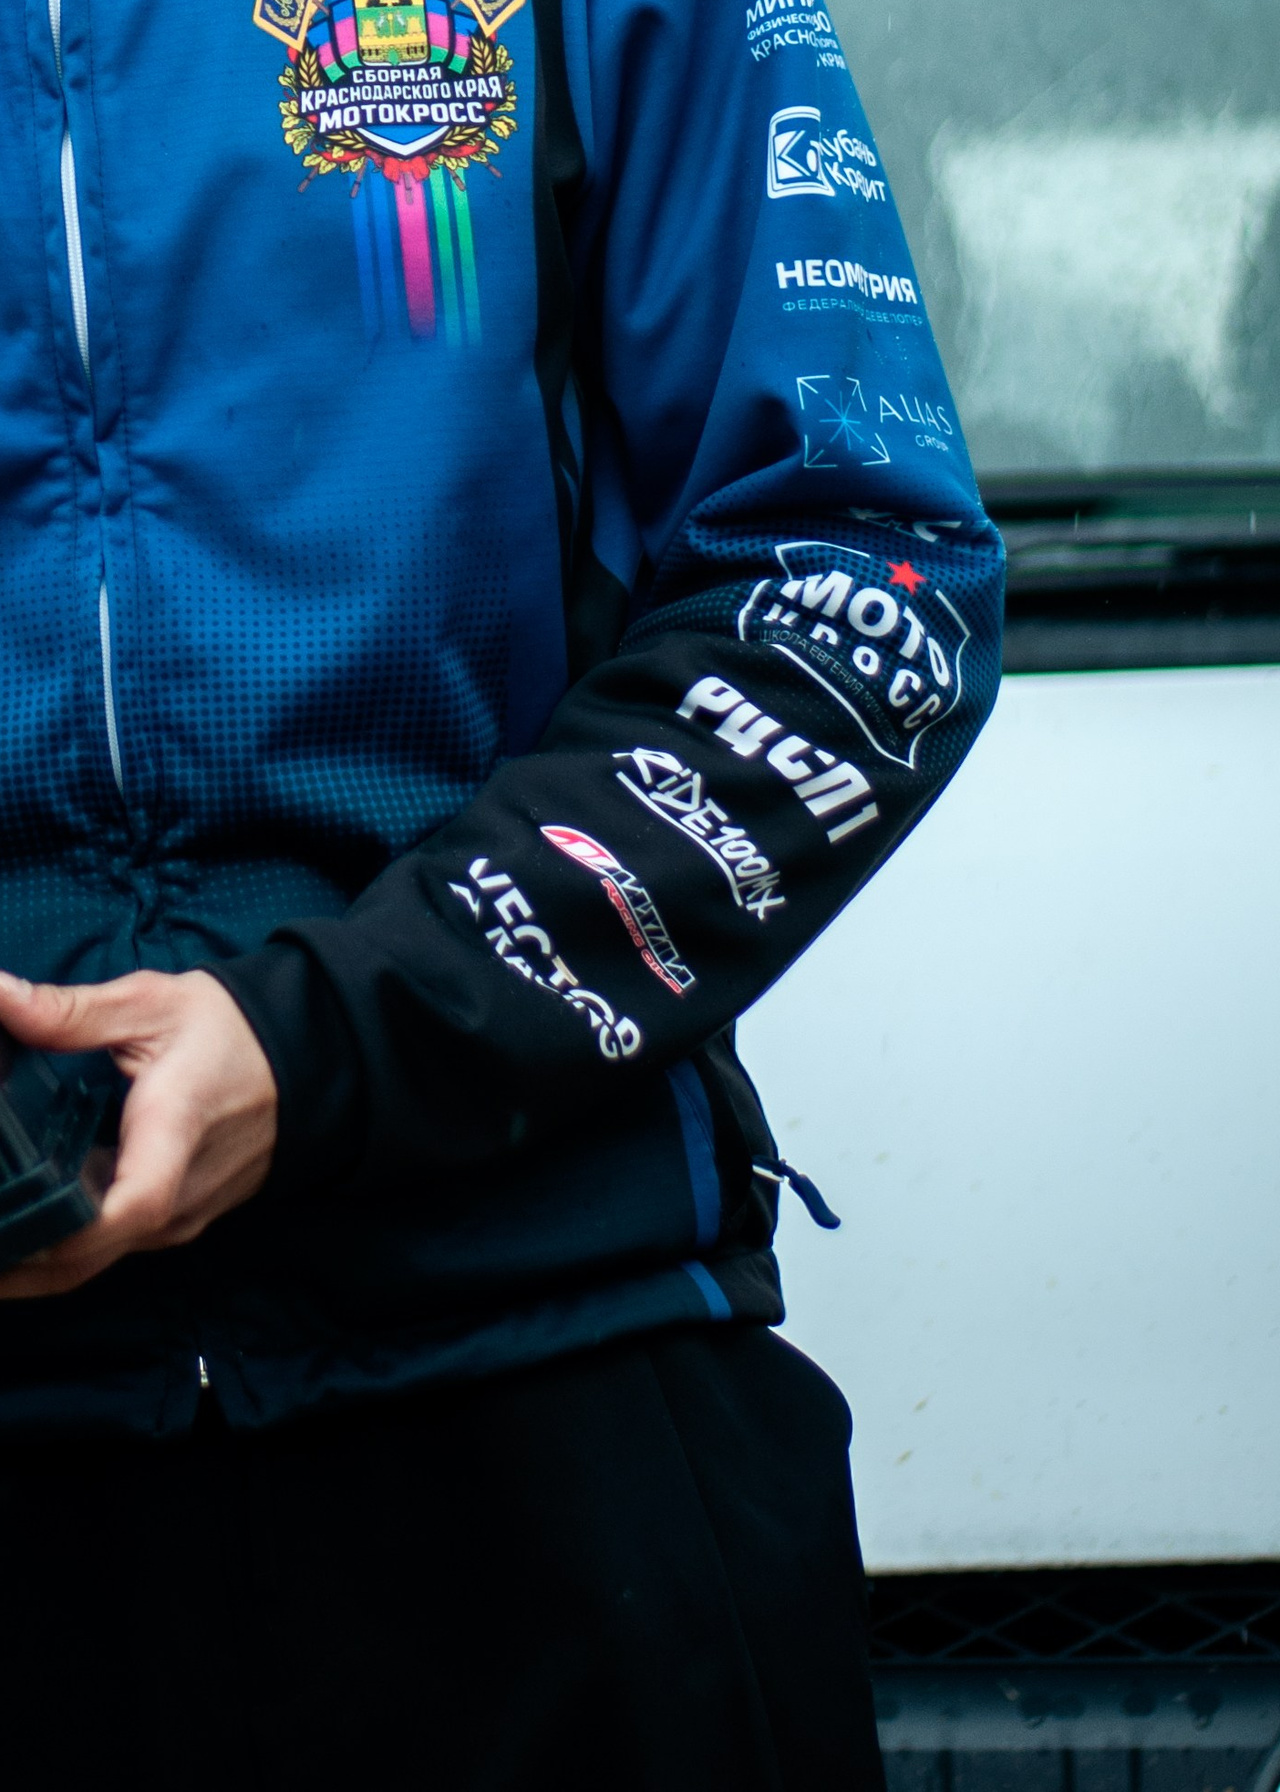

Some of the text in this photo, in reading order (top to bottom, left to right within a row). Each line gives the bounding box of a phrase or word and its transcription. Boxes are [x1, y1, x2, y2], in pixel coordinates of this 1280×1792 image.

[300, 75, 504, 114] КРАСНОДАРСКОГО КРАЯ
[352, 66, 442, 84] СБОРНАЯ
[319, 101, 487, 133] МОТОКРОСС
[775, 259, 918, 305] НЕОМТРИЯ
[879, 393, 953, 436] ALIAS
[809, 646, 865, 695] ЕВГЕНИЯ
